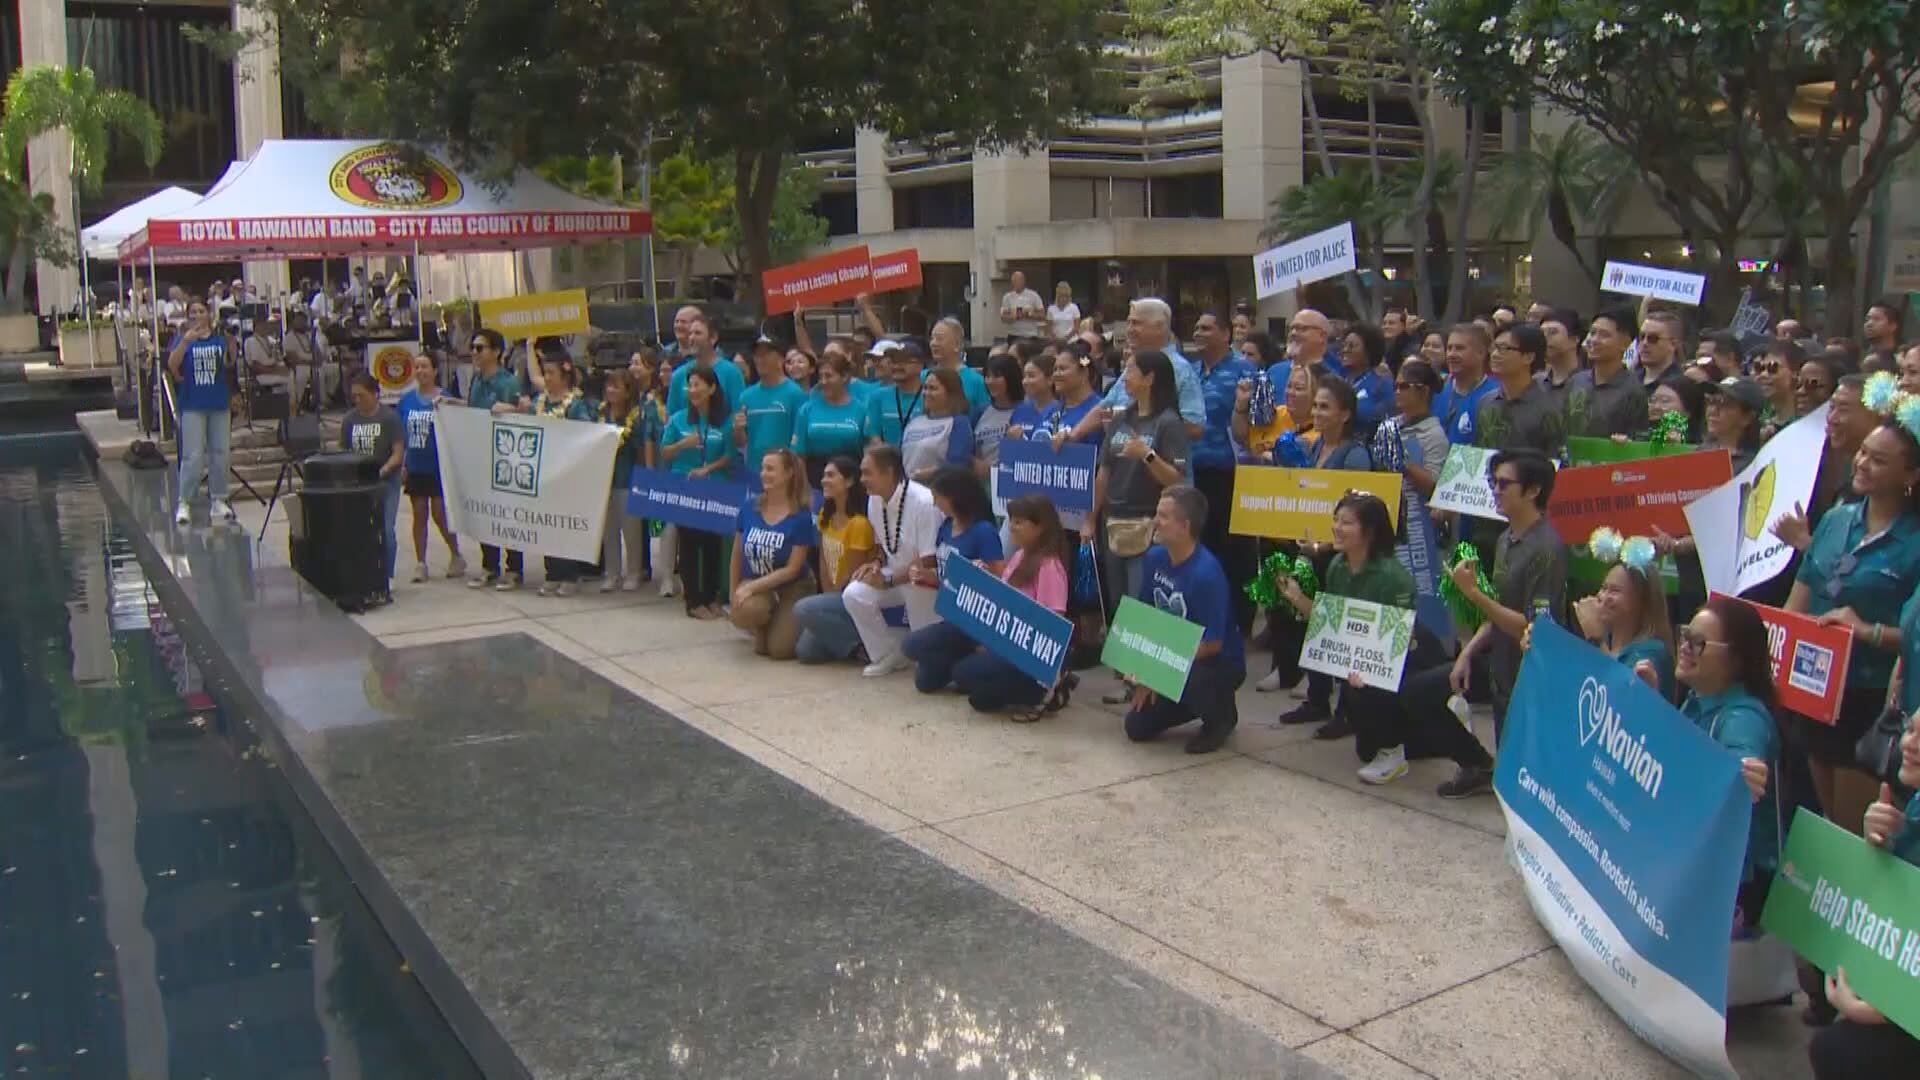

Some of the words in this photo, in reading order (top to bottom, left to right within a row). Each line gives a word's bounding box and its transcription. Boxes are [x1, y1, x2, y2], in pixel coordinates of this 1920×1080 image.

[180, 222, 235, 240] ROYAL
[239, 219, 326, 239] HAWAIIAN
[330, 218, 376, 238] BAND
[389, 218, 426, 237] CITY
[430, 217, 464, 236] AND
[466, 216, 529, 235] COUNTY
[532, 215, 551, 233] OF
[553, 214, 630, 232] HONOLULU
[1275, 254, 1304, 279] UNITED
[1304, 248, 1321, 269] FOR
[1322, 239, 1346, 264] ALICE
[783, 277, 809, 296] Create
[810, 270, 838, 290] Lasting
[838, 264, 869, 283] Change
[1624, 272, 1654, 290] UNITED
[1654, 276, 1672, 291] FOR
[1671, 280, 1697, 296] ALICE
[194, 370, 215, 386] WAY
[408, 409, 434, 421] UNITE
[1014, 460, 1042, 485] UNITED
[1043, 463, 1052, 487] IS
[1053, 465, 1069, 489] THE
[1070, 466, 1089, 491] WAY
[1454, 482, 1488, 498] BRUSH,
[648, 488, 667, 505] Every
[1240, 494, 1273, 511] Support
[1275, 495, 1296, 513] What
[1298, 496, 1331, 514] Matters
[1440, 490, 1458, 502] SEE
[1460, 494, 1487, 508] YOUR
[1647, 488, 1678, 506] Thriving
[462, 498, 511, 521] ATHOLIC
[514, 507, 590, 531] CHARITIES
[747, 527, 785, 549] UNITED
[1737, 543, 1785, 576] VELOP
[956, 583, 997, 626] UNITED
[995, 608, 1010, 636] IS
[1009, 615, 1034, 650] THE
[1031, 630, 1063, 667] WAY
[1764, 620, 1787, 661] OR
[1308, 648, 1330, 661] SEE
[1327, 654, 1353, 669] YOUR
[1353, 659, 1394, 681] DENTIST.
[1320, 638, 1352, 657] BRUSH,
[1353, 647, 1386, 665] FLOSS,
[1598, 705, 1663, 800] Navian
[1518, 766, 1539, 796] Care
[1538, 786, 1557, 814] with
[1555, 804, 1600, 863] compassion.
[1600, 848, 1632, 898] Rooted
[1628, 880, 1638, 908] in
[1636, 895, 1670, 941] aloha.
[1543, 871, 1575, 919] Palliative
[1576, 915, 1610, 965] Pediatric
[1611, 955, 1638, 989] Care
[1810, 874, 1849, 929] Help
[1845, 895, 1902, 961] Starts
[1897, 928, 1920, 977] He
